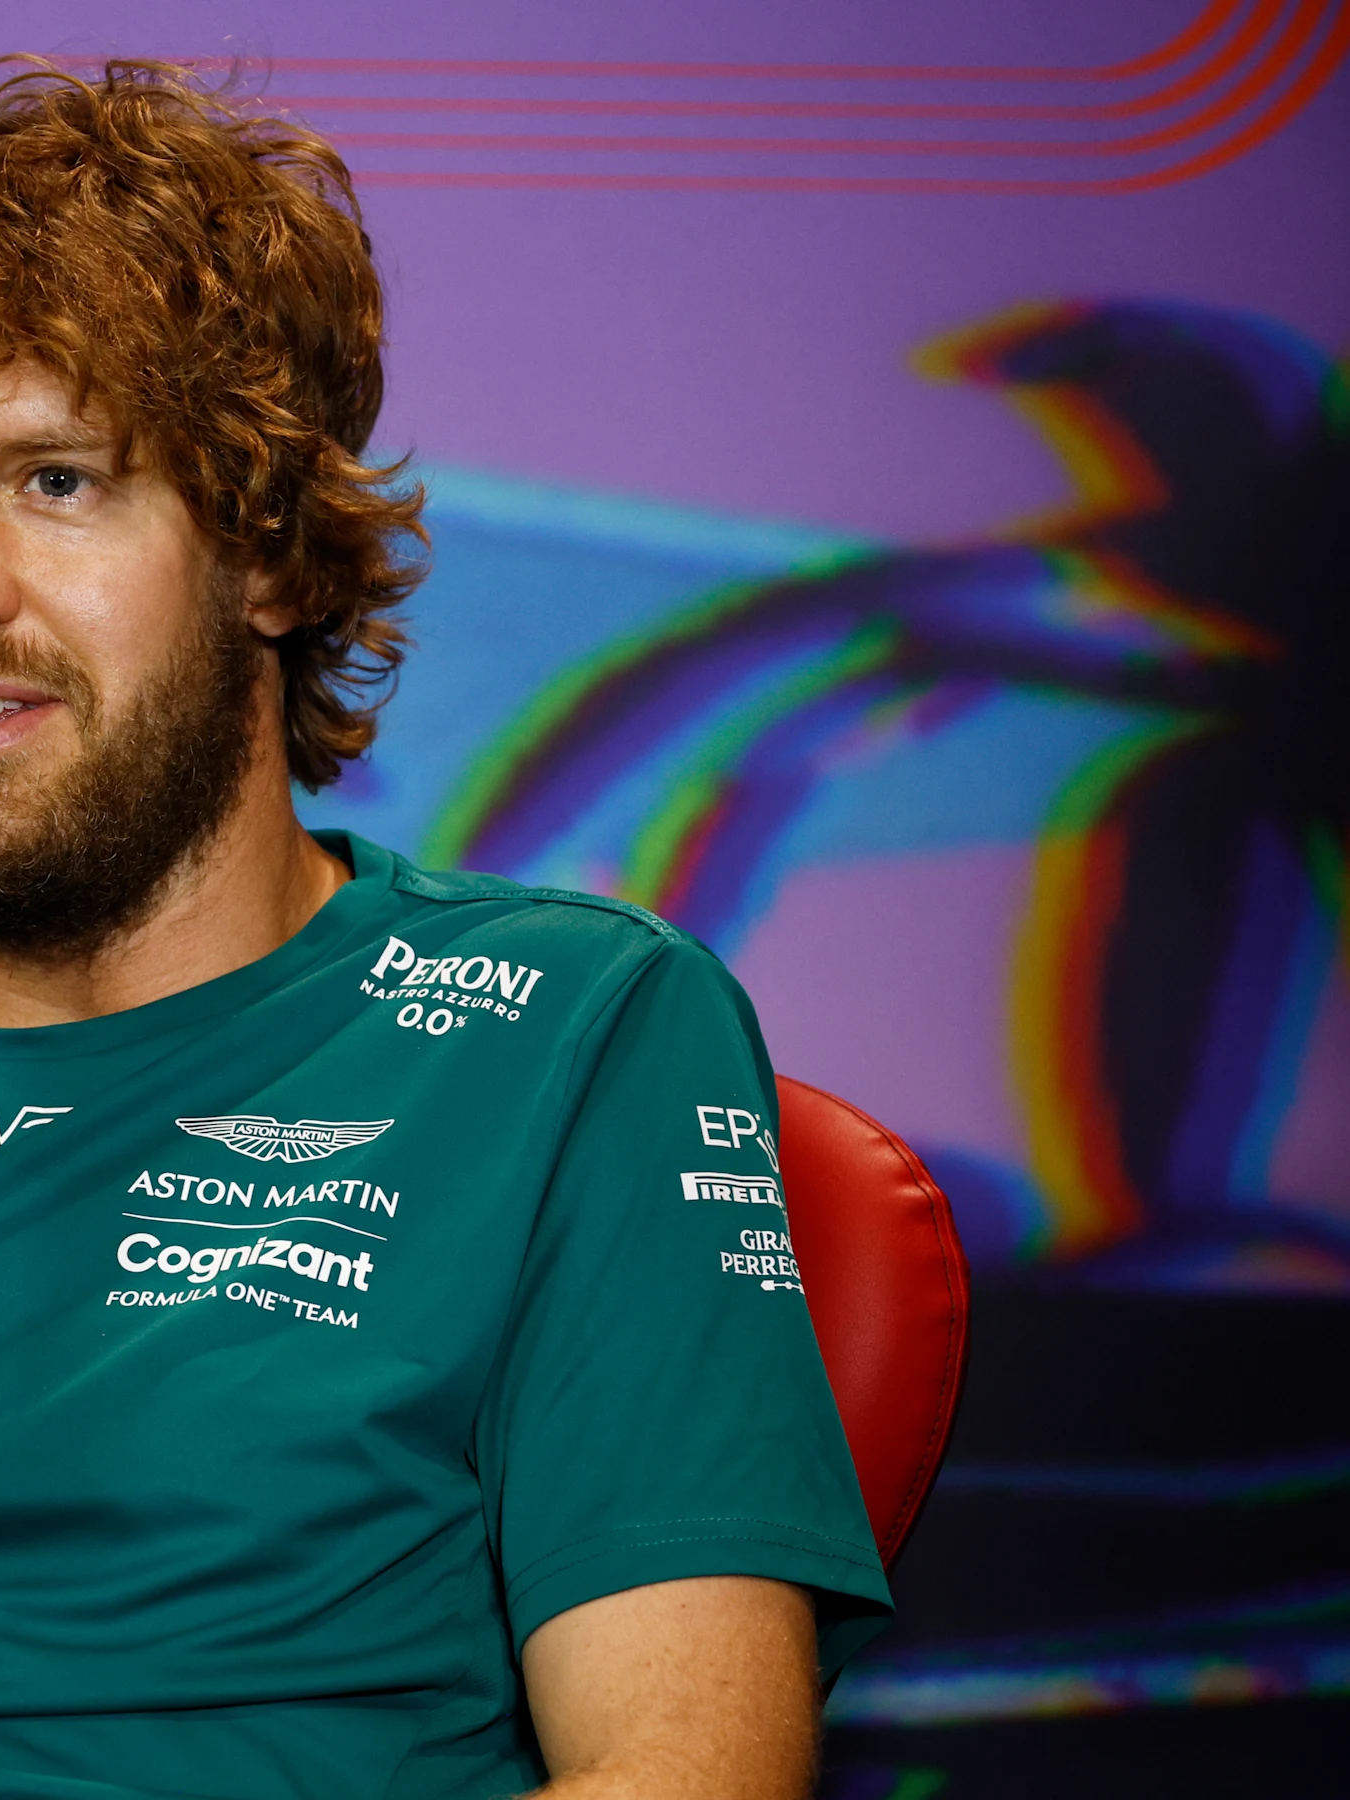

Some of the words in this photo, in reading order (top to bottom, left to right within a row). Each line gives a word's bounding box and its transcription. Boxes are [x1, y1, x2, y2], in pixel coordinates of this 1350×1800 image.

[370, 936, 544, 1005] PERONI
[359, 979, 429, 1001] NASTRO
[431, 989, 521, 1022] AZZURRO
[396, 1002, 469, 1036] 0.0%
[235, 1124, 280, 1138] ASTON
[281, 1128, 332, 1142] MARTIN
[127, 1170, 255, 1208] ASTON
[263, 1180, 400, 1218] MARTIN
[116, 1232, 374, 1292] Cognizant
[105, 1285, 218, 1307] FORMULA
[292, 1299, 359, 1330] TEAM
